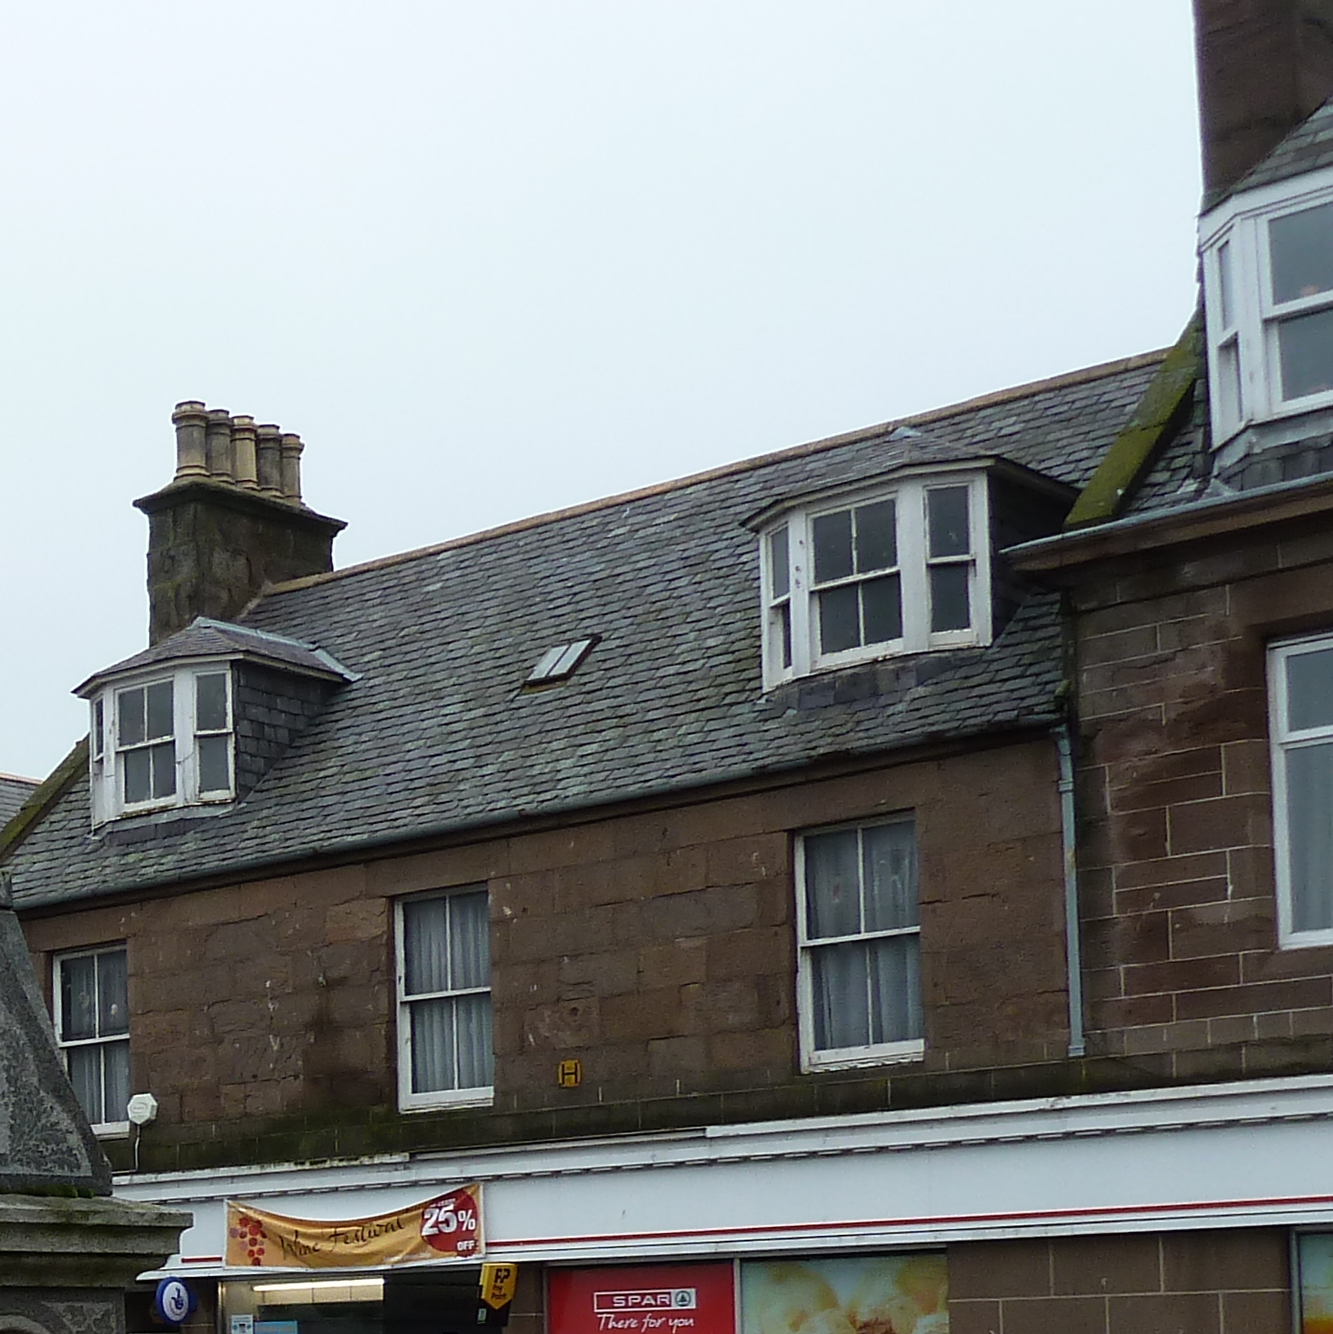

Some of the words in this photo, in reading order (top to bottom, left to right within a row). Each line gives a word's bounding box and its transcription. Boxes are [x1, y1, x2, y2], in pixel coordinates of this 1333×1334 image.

[560, 1062, 579, 1085] H
[421, 1203, 476, 1236] 25%
[457, 1240, 475, 1251] OFF
[613, 1294, 670, 1307] SPAR
[597, 1313, 639, 1331] There
[641, 1313, 666, 1333] for
[668, 1317, 695, 1334] you
